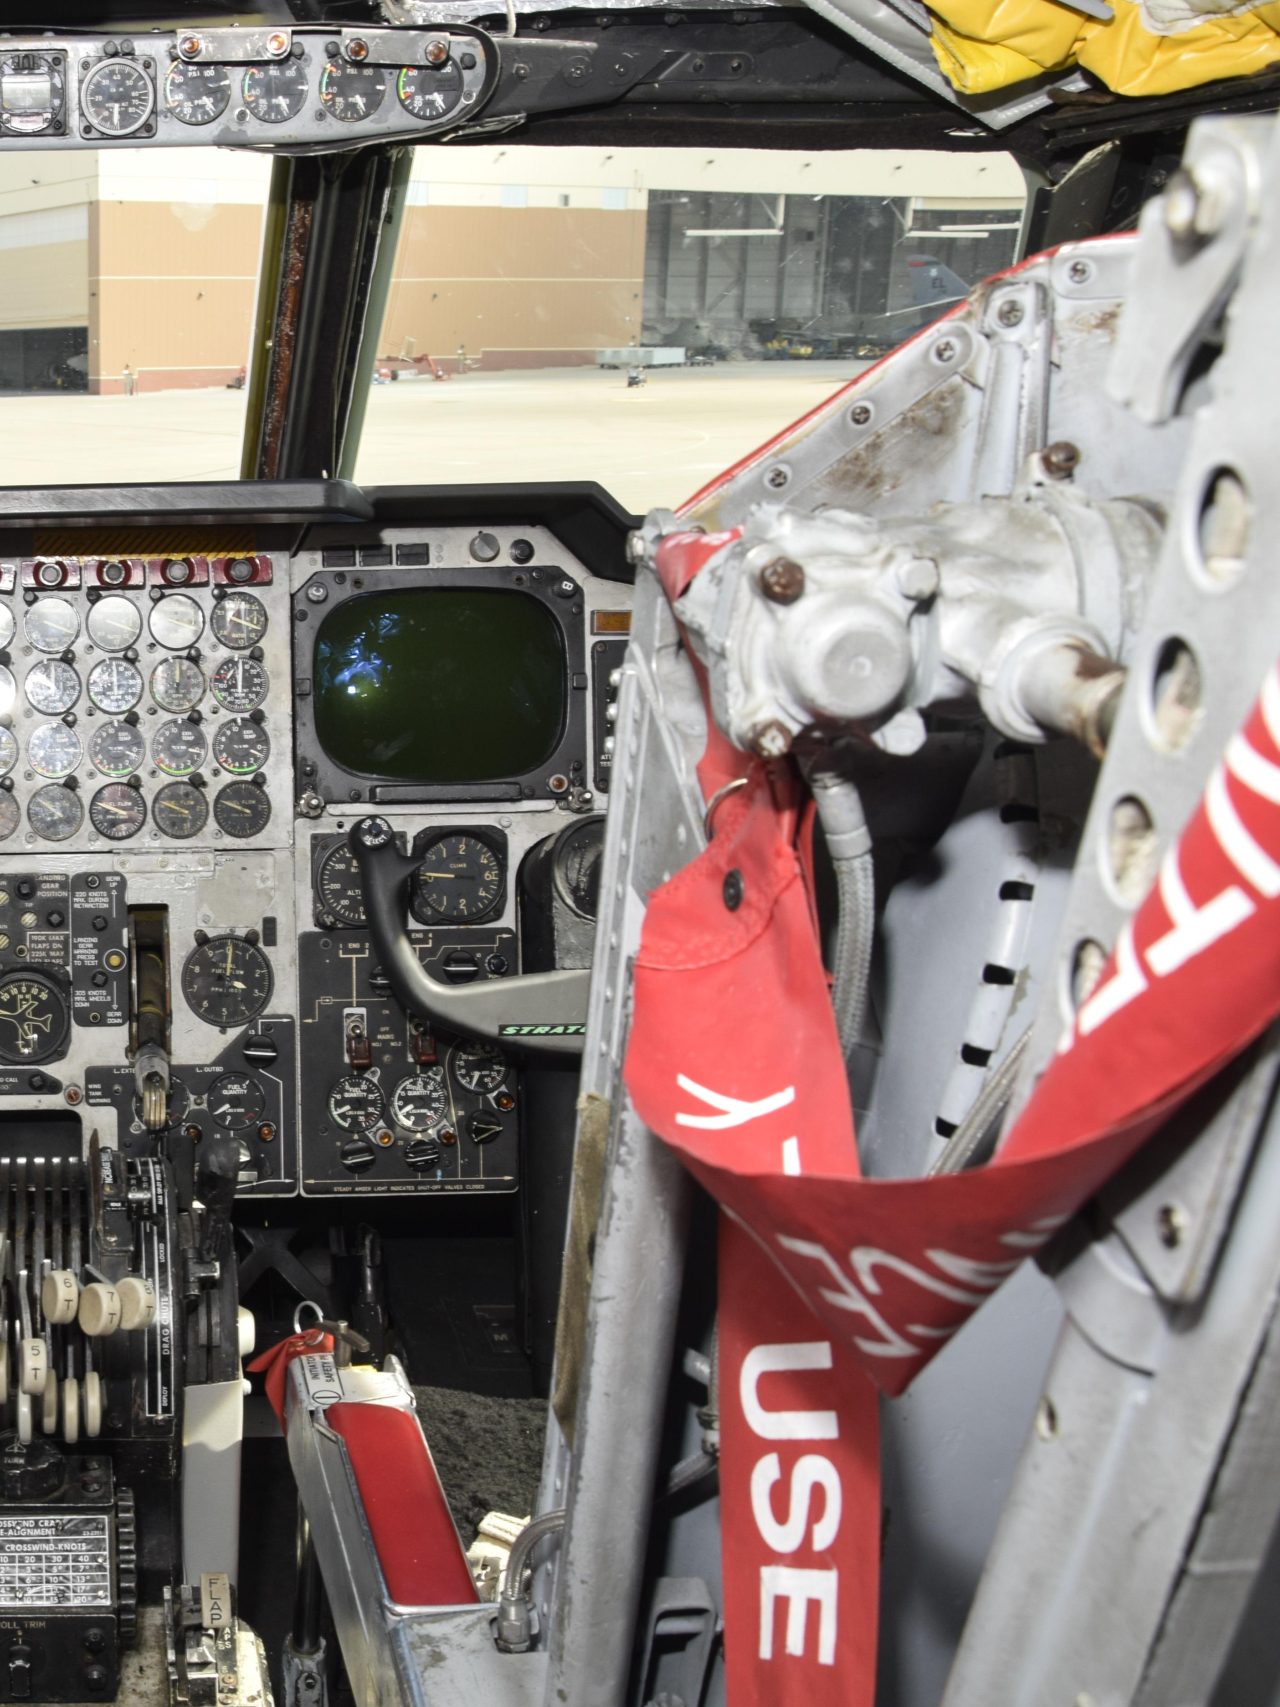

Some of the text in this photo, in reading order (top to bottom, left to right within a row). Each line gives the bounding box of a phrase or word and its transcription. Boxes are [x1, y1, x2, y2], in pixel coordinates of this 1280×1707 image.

[364, 834, 387, 846] SELECT
[459, 845, 465, 854] 2
[1, 993, 10, 1001] 20
[64, 1278, 72, 1288] 6
[106, 1291, 115, 1302] 7
[64, 1299, 73, 1310] T
[108, 1313, 117, 1324] T
[161, 1297, 170, 1355] DRAG CHUTE
[31, 1345, 40, 1356] 5
[31, 1367, 41, 1380] T
[321, 1361, 336, 1383] SAFETY
[739, 1341, 843, 1665] USE
[5, 1543, 87, 1552] CROSSWIND-KNOTS
[208, 1578, 222, 1625] FLAP
[224, 1626, 232, 1649] APS
